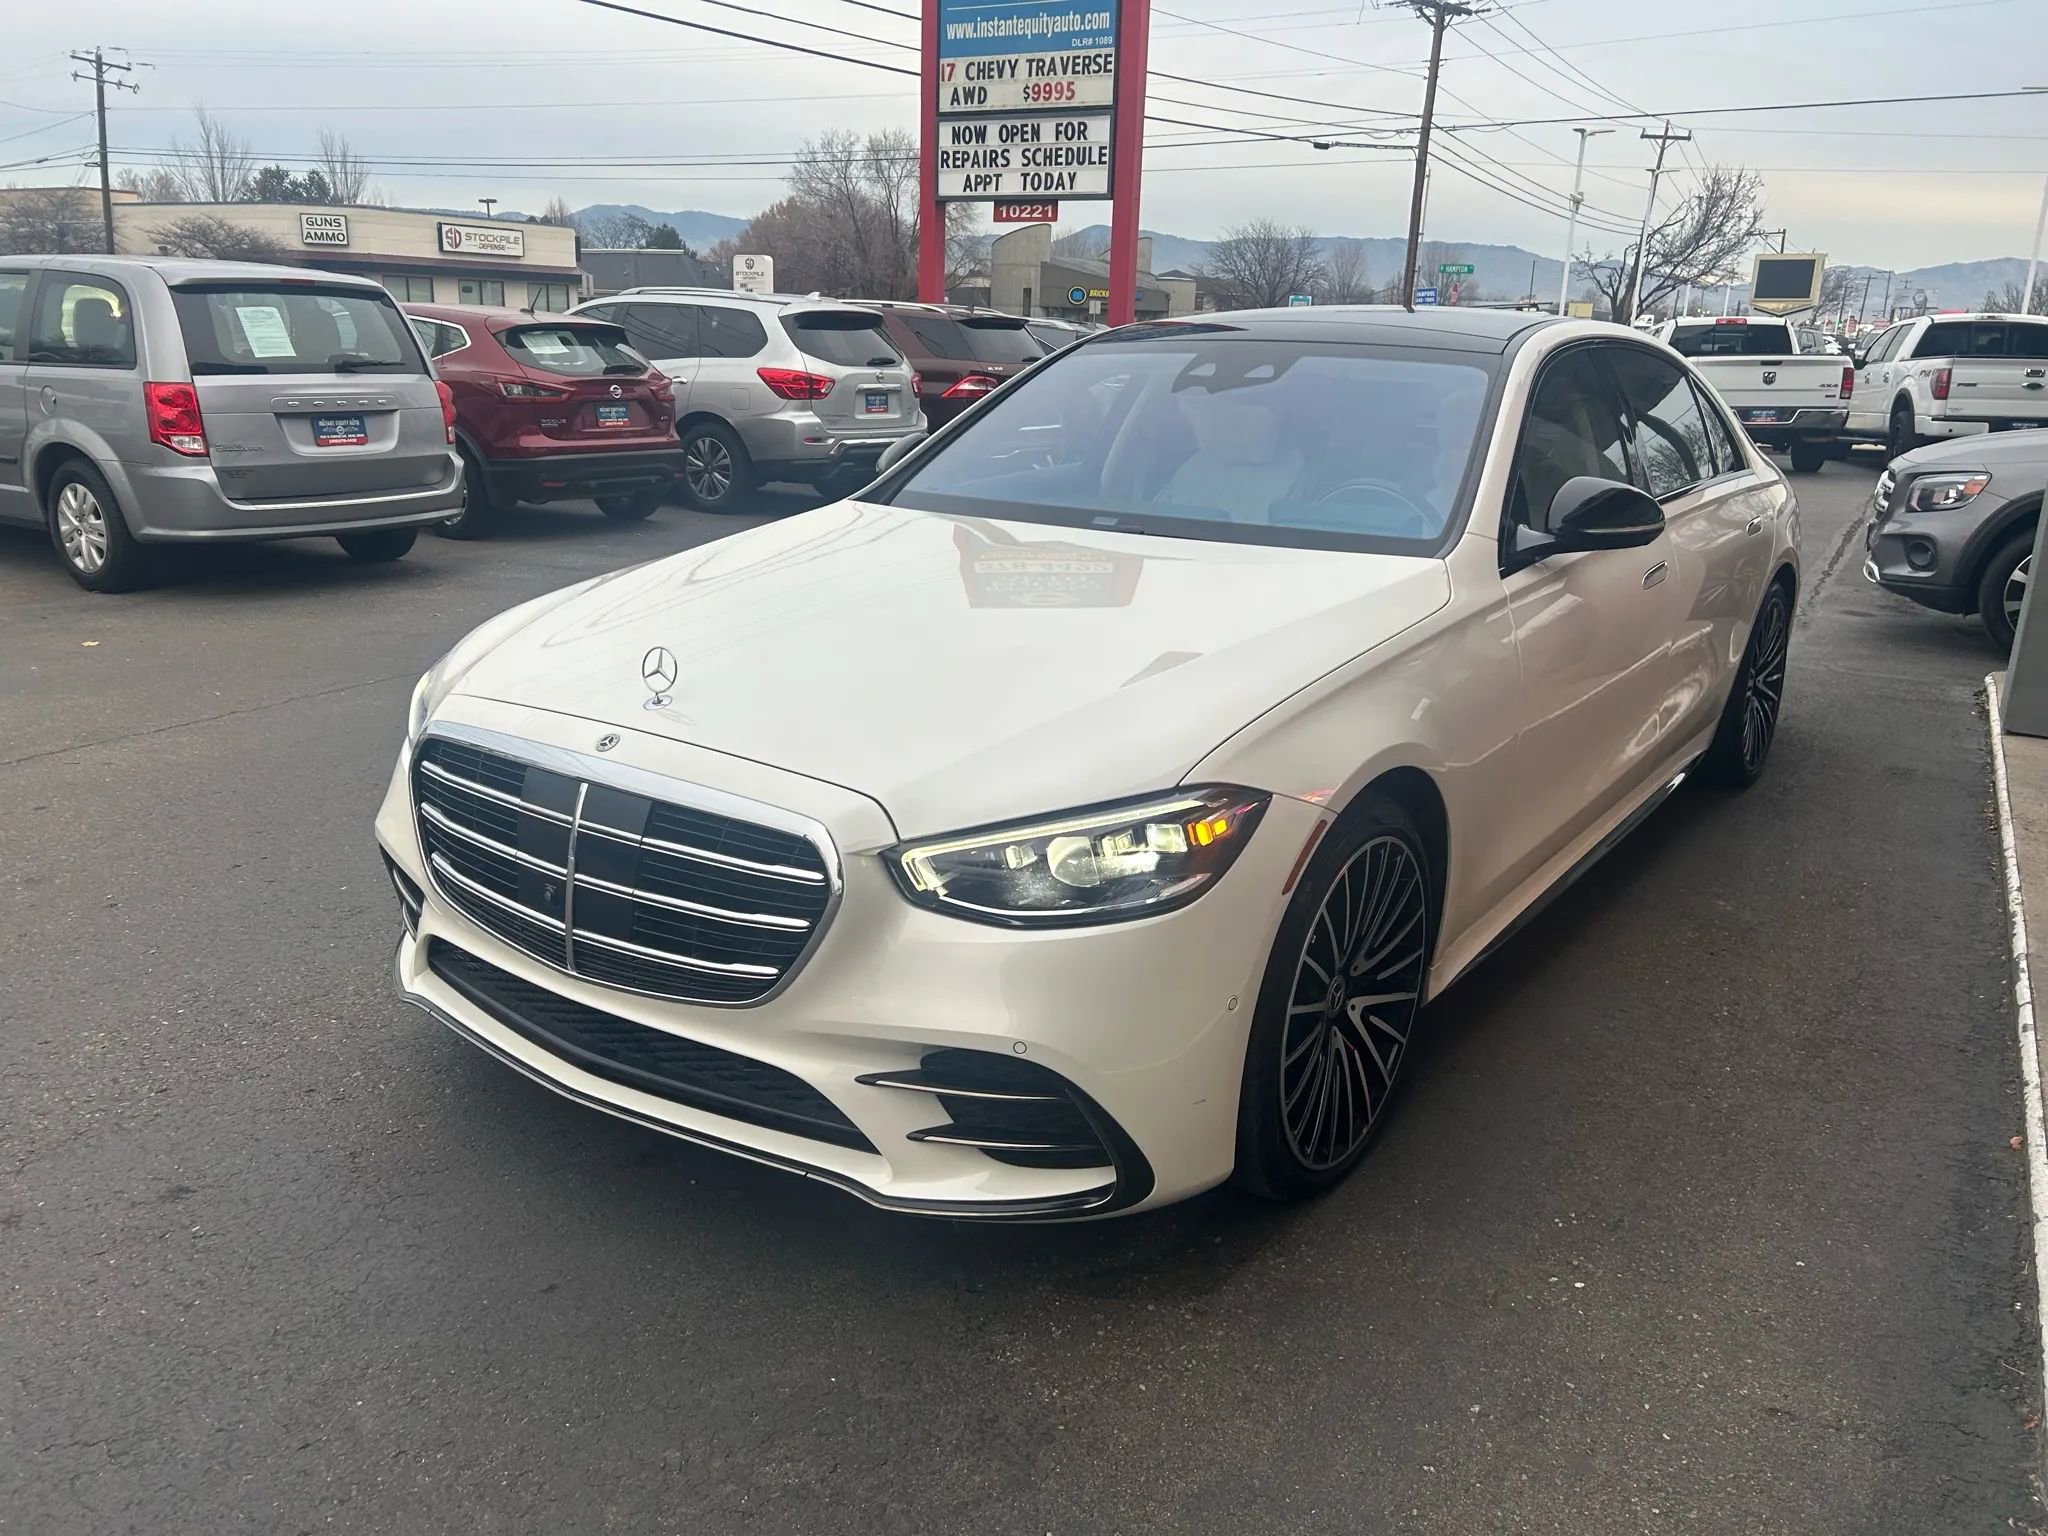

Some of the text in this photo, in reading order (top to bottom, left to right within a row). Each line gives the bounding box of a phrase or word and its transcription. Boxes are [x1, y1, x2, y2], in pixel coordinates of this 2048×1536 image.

[946, 11, 1110, 40] www.instantequityauto.com
[1071, 36, 1113, 47] DLR# 1089
[941, 53, 1113, 82] 17 CHEVY TRAVERSE
[950, 81, 1076, 106] AWD $9995
[951, 121, 1088, 145] NOW OPEN FOR
[941, 146, 1107, 169] REPAIRS SCHEDULE
[963, 172, 1077, 193] APPT TODAY
[999, 204, 1053, 218] 10221
[305, 216, 342, 228] GUNS
[304, 231, 346, 243] AMMO
[464, 232, 521, 245] STOCKPILE
[478, 243, 506, 251] DEFENSE
[1445, 265, 1468, 273] HAMPTON
